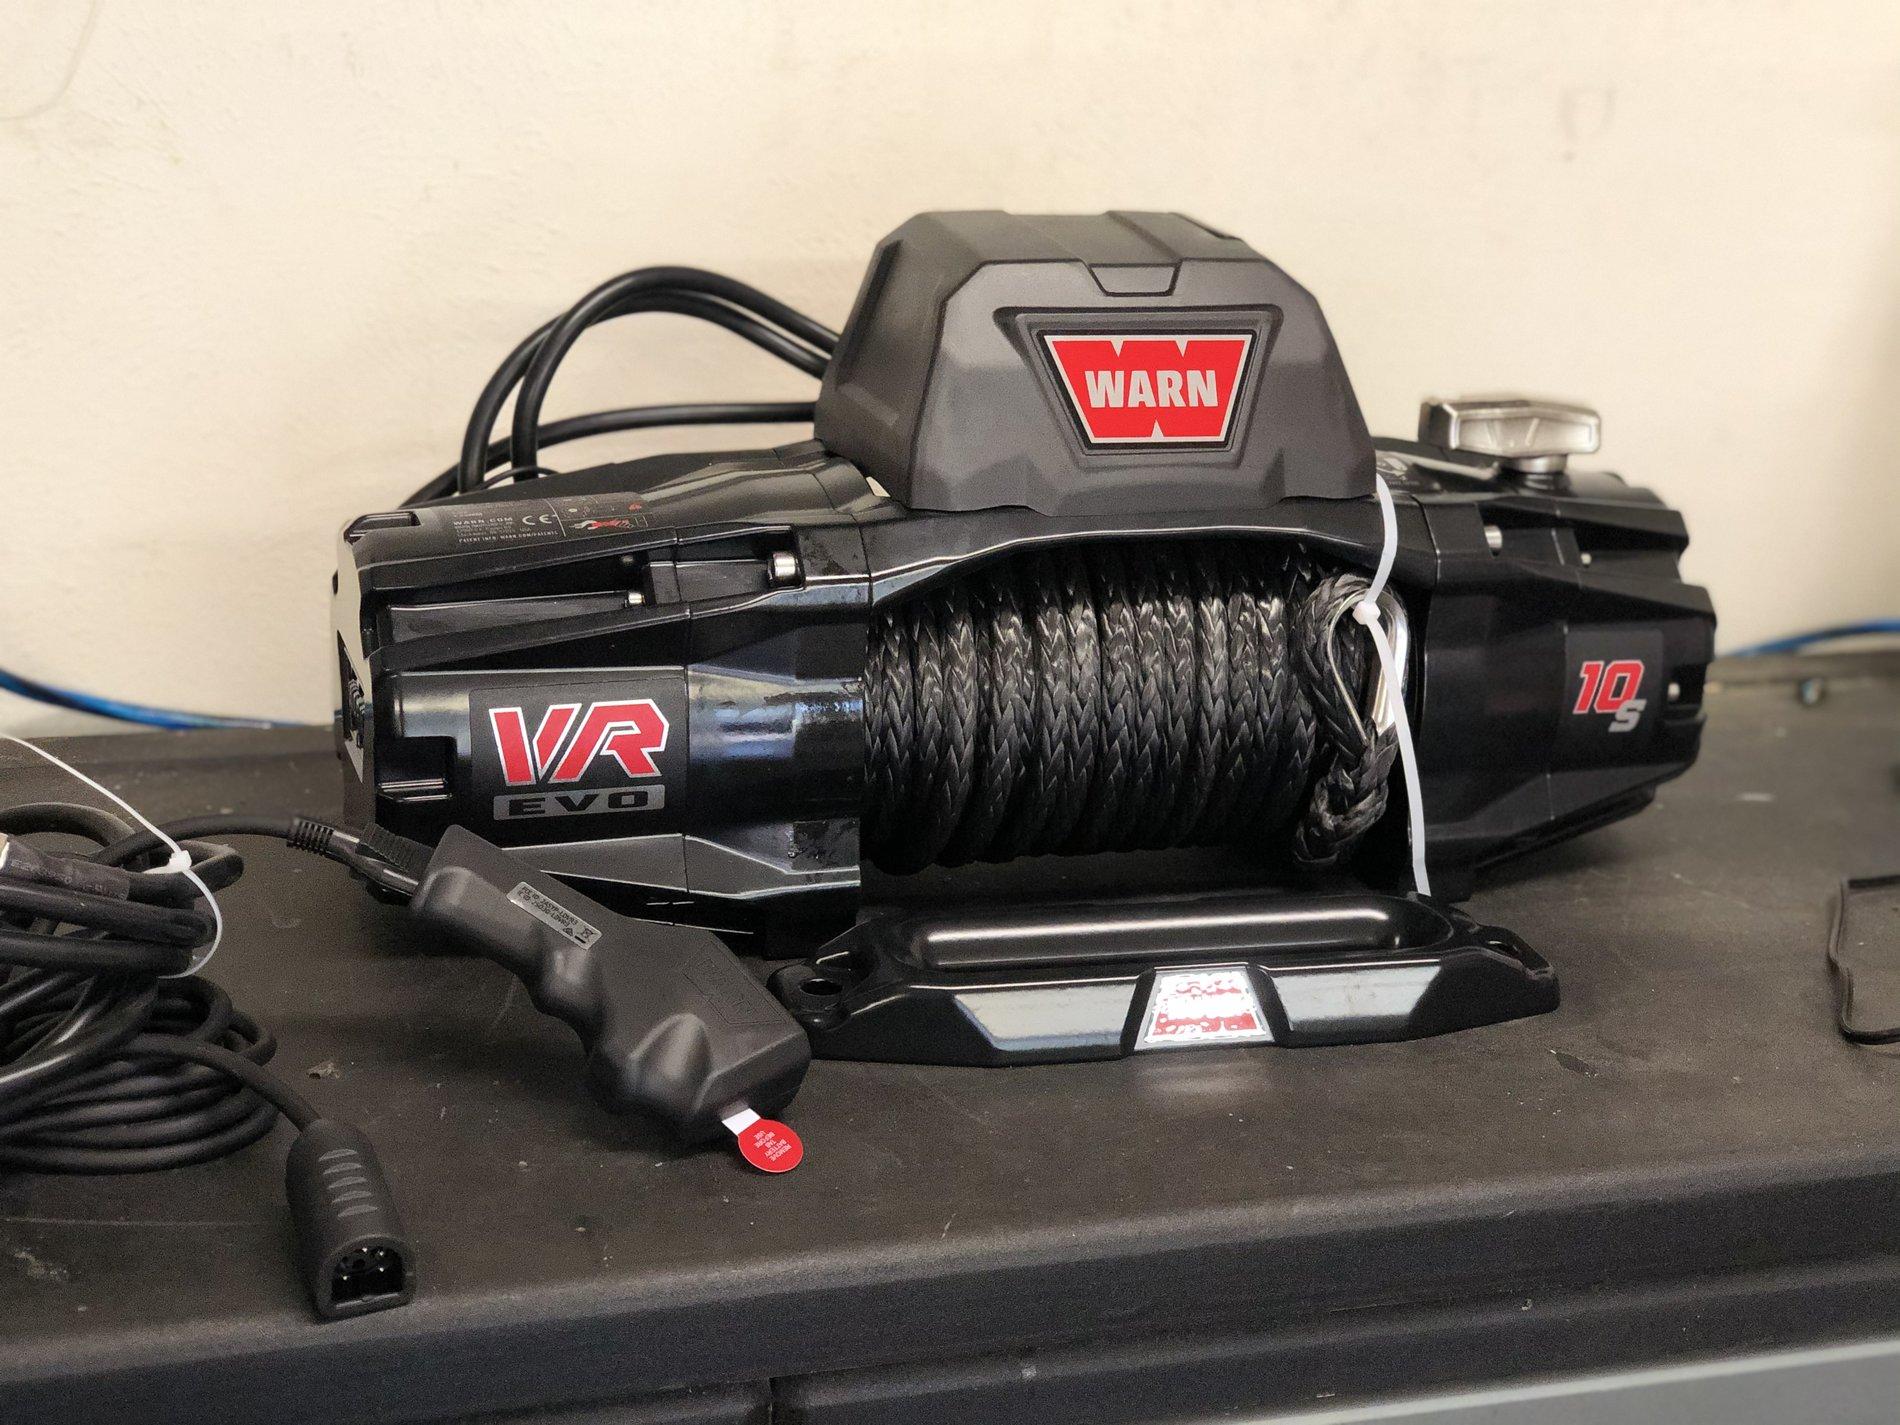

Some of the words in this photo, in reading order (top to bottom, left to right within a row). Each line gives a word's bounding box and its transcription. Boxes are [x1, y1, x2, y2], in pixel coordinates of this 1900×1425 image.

[1085, 370, 1218, 408] WARN
[489, 699, 670, 786] VR
[509, 791, 648, 815] EVO
[753, 1131, 775, 1148] BEFORE
[764, 1138, 787, 1157] BATTERY
[768, 1143, 792, 1162] REMOVE
